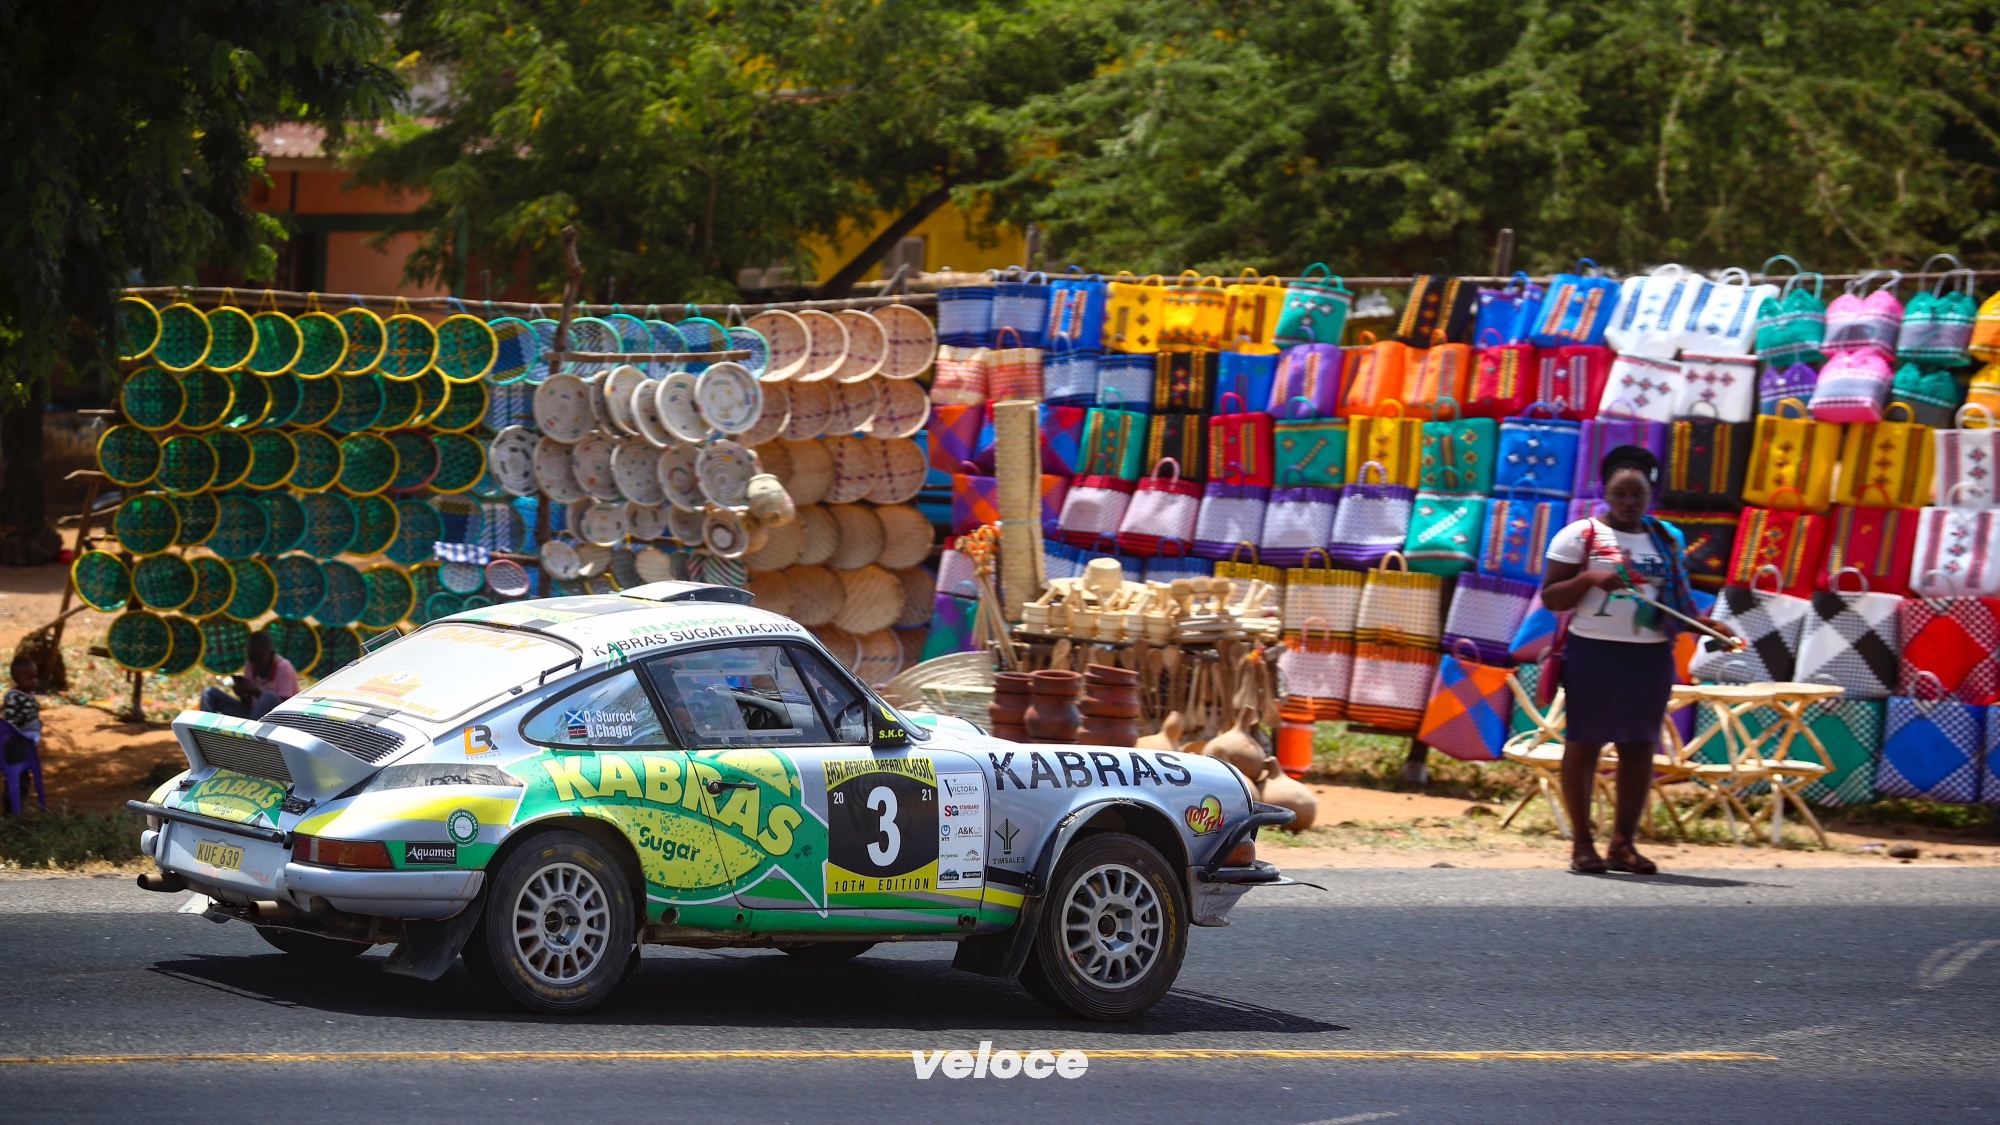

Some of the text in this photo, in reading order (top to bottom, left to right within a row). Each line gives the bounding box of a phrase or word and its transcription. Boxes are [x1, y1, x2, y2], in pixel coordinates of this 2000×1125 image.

[628, 616, 748, 636] #TEJSTRONG
[591, 622, 801, 657] KABRAS SUGAR RACING
[584, 709, 637, 722] D. Sturrock
[586, 723, 633, 738] B.Chager
[879, 729, 904, 739] S.K.C
[825, 758, 933, 785] EAST AFRICAN SAFARI CLASSIC
[988, 752, 1192, 791] KABRAS
[194, 778, 283, 809] KABRAS
[833, 788, 932, 804] 20 21
[950, 785, 978, 793] VICTORIA
[213, 803, 235, 815] Sugar
[541, 754, 803, 857] KABRAS
[944, 805, 959, 817] SG
[449, 811, 462, 830] CARBON
[1186, 807, 1209, 825] Top
[1204, 815, 1226, 832] Fry
[866, 786, 901, 867] 3
[638, 826, 700, 861] Sugar
[196, 843, 240, 867] KUF 639
[406, 845, 456, 861] Aquamist
[993, 856, 1026, 865] TIMSALES
[835, 878, 930, 892] 10TH EDITION
